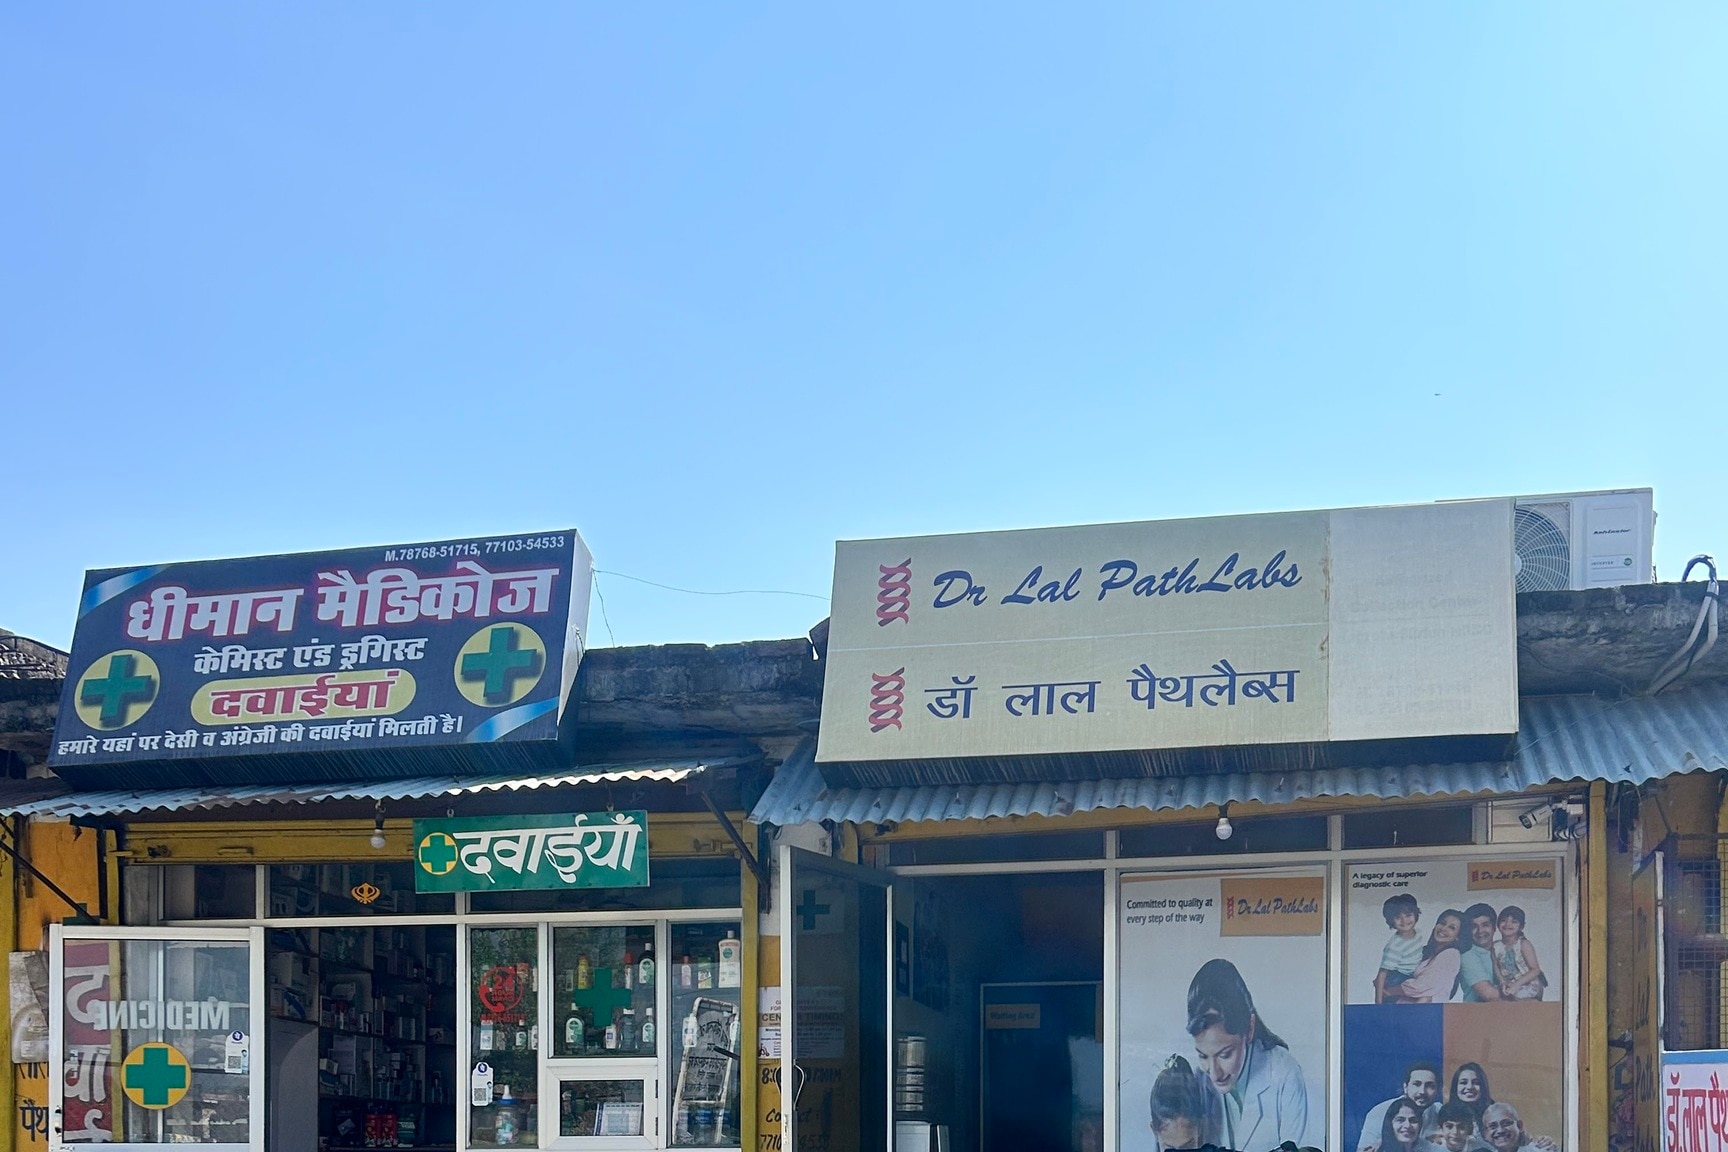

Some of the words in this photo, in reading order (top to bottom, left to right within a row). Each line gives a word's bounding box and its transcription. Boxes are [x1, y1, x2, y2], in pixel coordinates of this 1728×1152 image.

[485, 536, 565, 553] 77103-54533
[933, 570, 988, 609] Dr
[1000, 565, 1081, 607] Lal
[1098, 549, 1303, 600] PathLabs
[127, 586, 305, 641] धीमान
[317, 561, 560, 627] मैडिकोज
[194, 645, 287, 674] केमिस्ट
[293, 638, 335, 668] एंड
[339, 635, 428, 670] ड्रगिस्ट
[210, 670, 400, 718] दवाईयां
[925, 675, 977, 719] डॉ
[1002, 681, 1101, 713] लाल
[1127, 659, 1300, 710] पैथलैब्स
[58, 736, 99, 755] हमारे
[102, 733, 137, 751] यहां
[139, 736, 161, 750] पर
[164, 730, 199, 748] देसी
[203, 732, 217, 746] व
[220, 725, 278, 745] अंग्रेजी
[280, 723, 305, 742] की
[309, 718, 377, 741] दवाईयां
[378, 716, 438, 737] मिलती
[453, 813, 643, 884] दवाईयाँ
[1352, 881, 1392, 889] diagnostic
[1360, 872, 1384, 881] legacy
[1396, 871, 1428, 879] superior
[1481, 871, 1494, 880] Dr
[1126, 898, 1167, 909] Committed
[1168, 898, 1177, 908] to
[1178, 897, 1204, 909] quality
[1204, 898, 1213, 907] at
[1237, 899, 1252, 915] Dr
[1252, 898, 1273, 914] Lal
[1272, 896, 1318, 914] PathLabs
[1126, 914, 1147, 925] every
[1148, 913, 1164, 925] step
[1165, 912, 1175, 922] of
[1175, 912, 1187, 922] the
[1188, 912, 1205, 923] way
